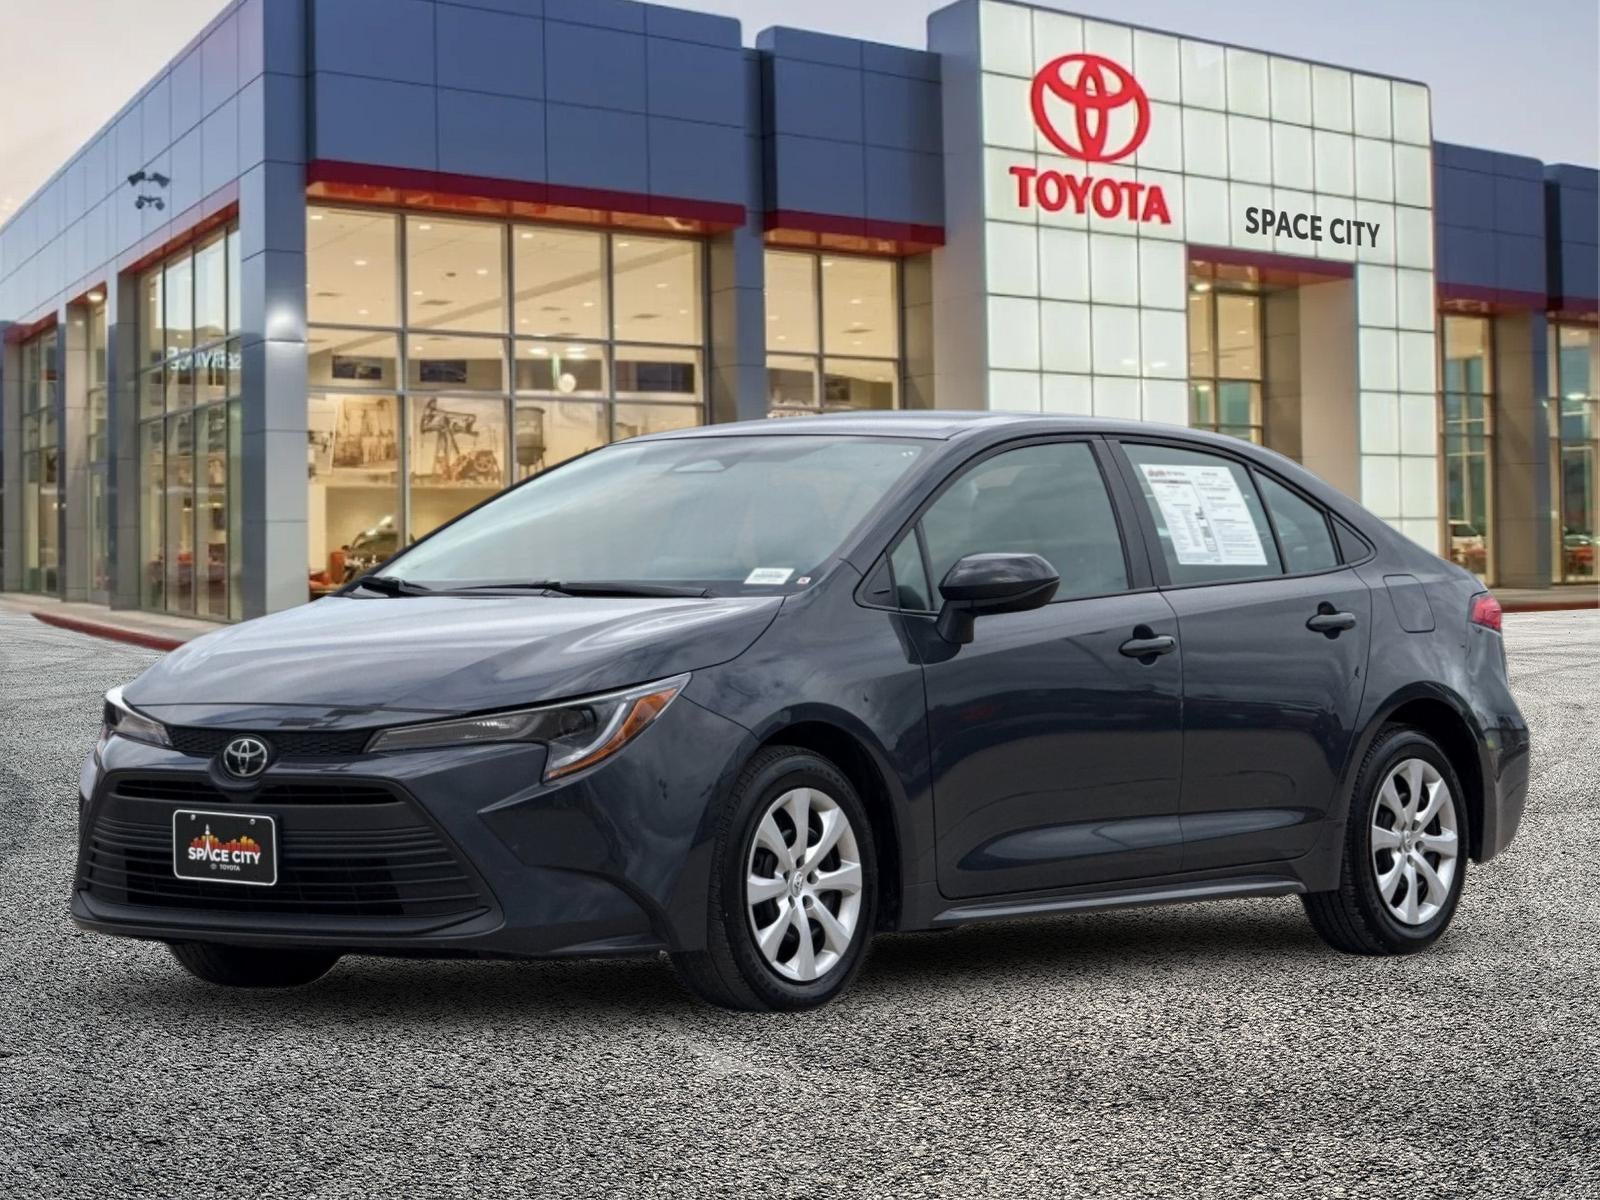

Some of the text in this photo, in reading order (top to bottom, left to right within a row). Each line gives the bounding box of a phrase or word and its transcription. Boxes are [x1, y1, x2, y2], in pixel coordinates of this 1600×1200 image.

[1009, 166, 1171, 224] TOYOTA
[1245, 207, 1380, 247] SPACE CITY
[188, 843, 260, 864] SPACE CITY
[219, 864, 240, 872] TOYOTA
